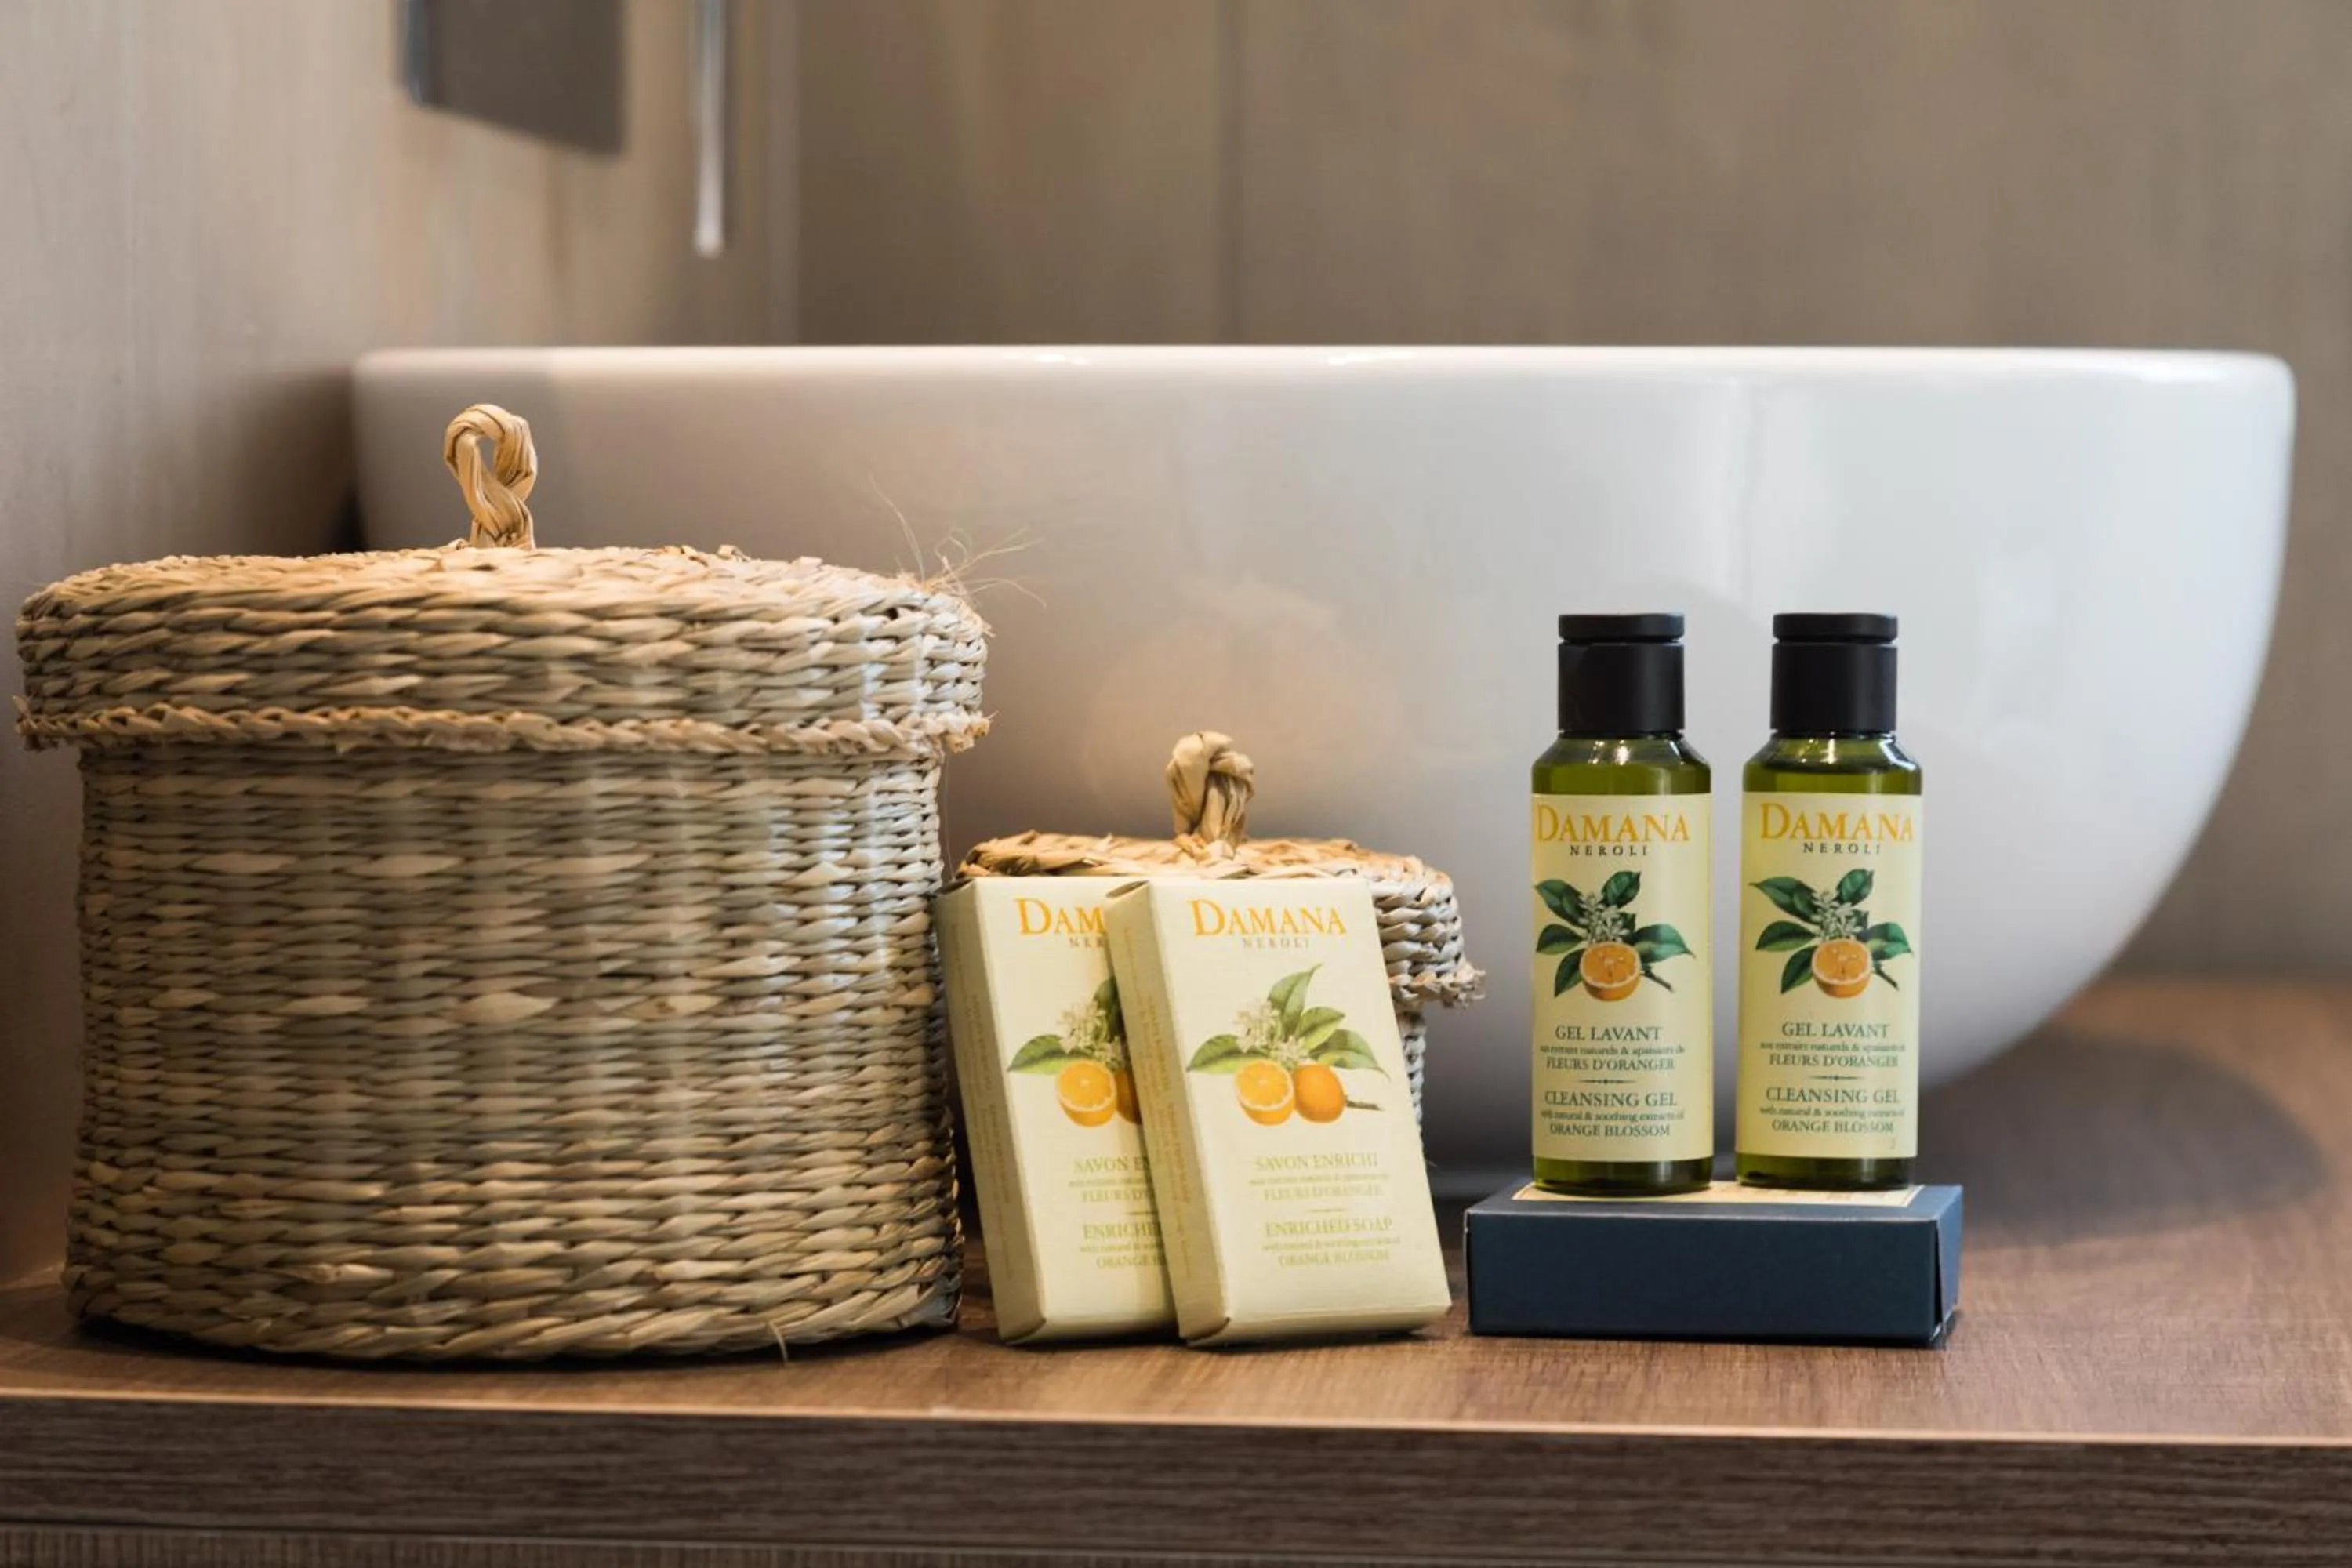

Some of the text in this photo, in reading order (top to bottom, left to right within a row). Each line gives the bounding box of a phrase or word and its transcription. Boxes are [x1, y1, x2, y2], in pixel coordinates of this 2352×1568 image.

[1570, 845, 1648, 856] NEROLI
[1803, 842, 1881, 855] NEROLI
[1014, 898, 1107, 935] DAM
[1069, 937, 1105, 949] NER
[1555, 1025, 1663, 1042] GEL LAVANT
[1782, 1021, 1890, 1039] GEL LAVANT
[1546, 1057, 1675, 1071] FLEURS D'ORANGER
[1769, 1053, 1898, 1068] FLEURS D'ORANGER
[1544, 1090, 1677, 1107] CLEANSING GEL
[1766, 1087, 1900, 1104] CLEANSING GEL
[1550, 1123, 1670, 1138] ORANGE BLOSSOM
[1773, 1119, 1893, 1134] ORANGE BLOSSOM
[1073, 1156, 1129, 1174] SAVON
[1254, 1153, 1308, 1171] SAVON
[1083, 1223, 1156, 1239] ENRICHE
[1352, 1215, 1393, 1232] SOAP
